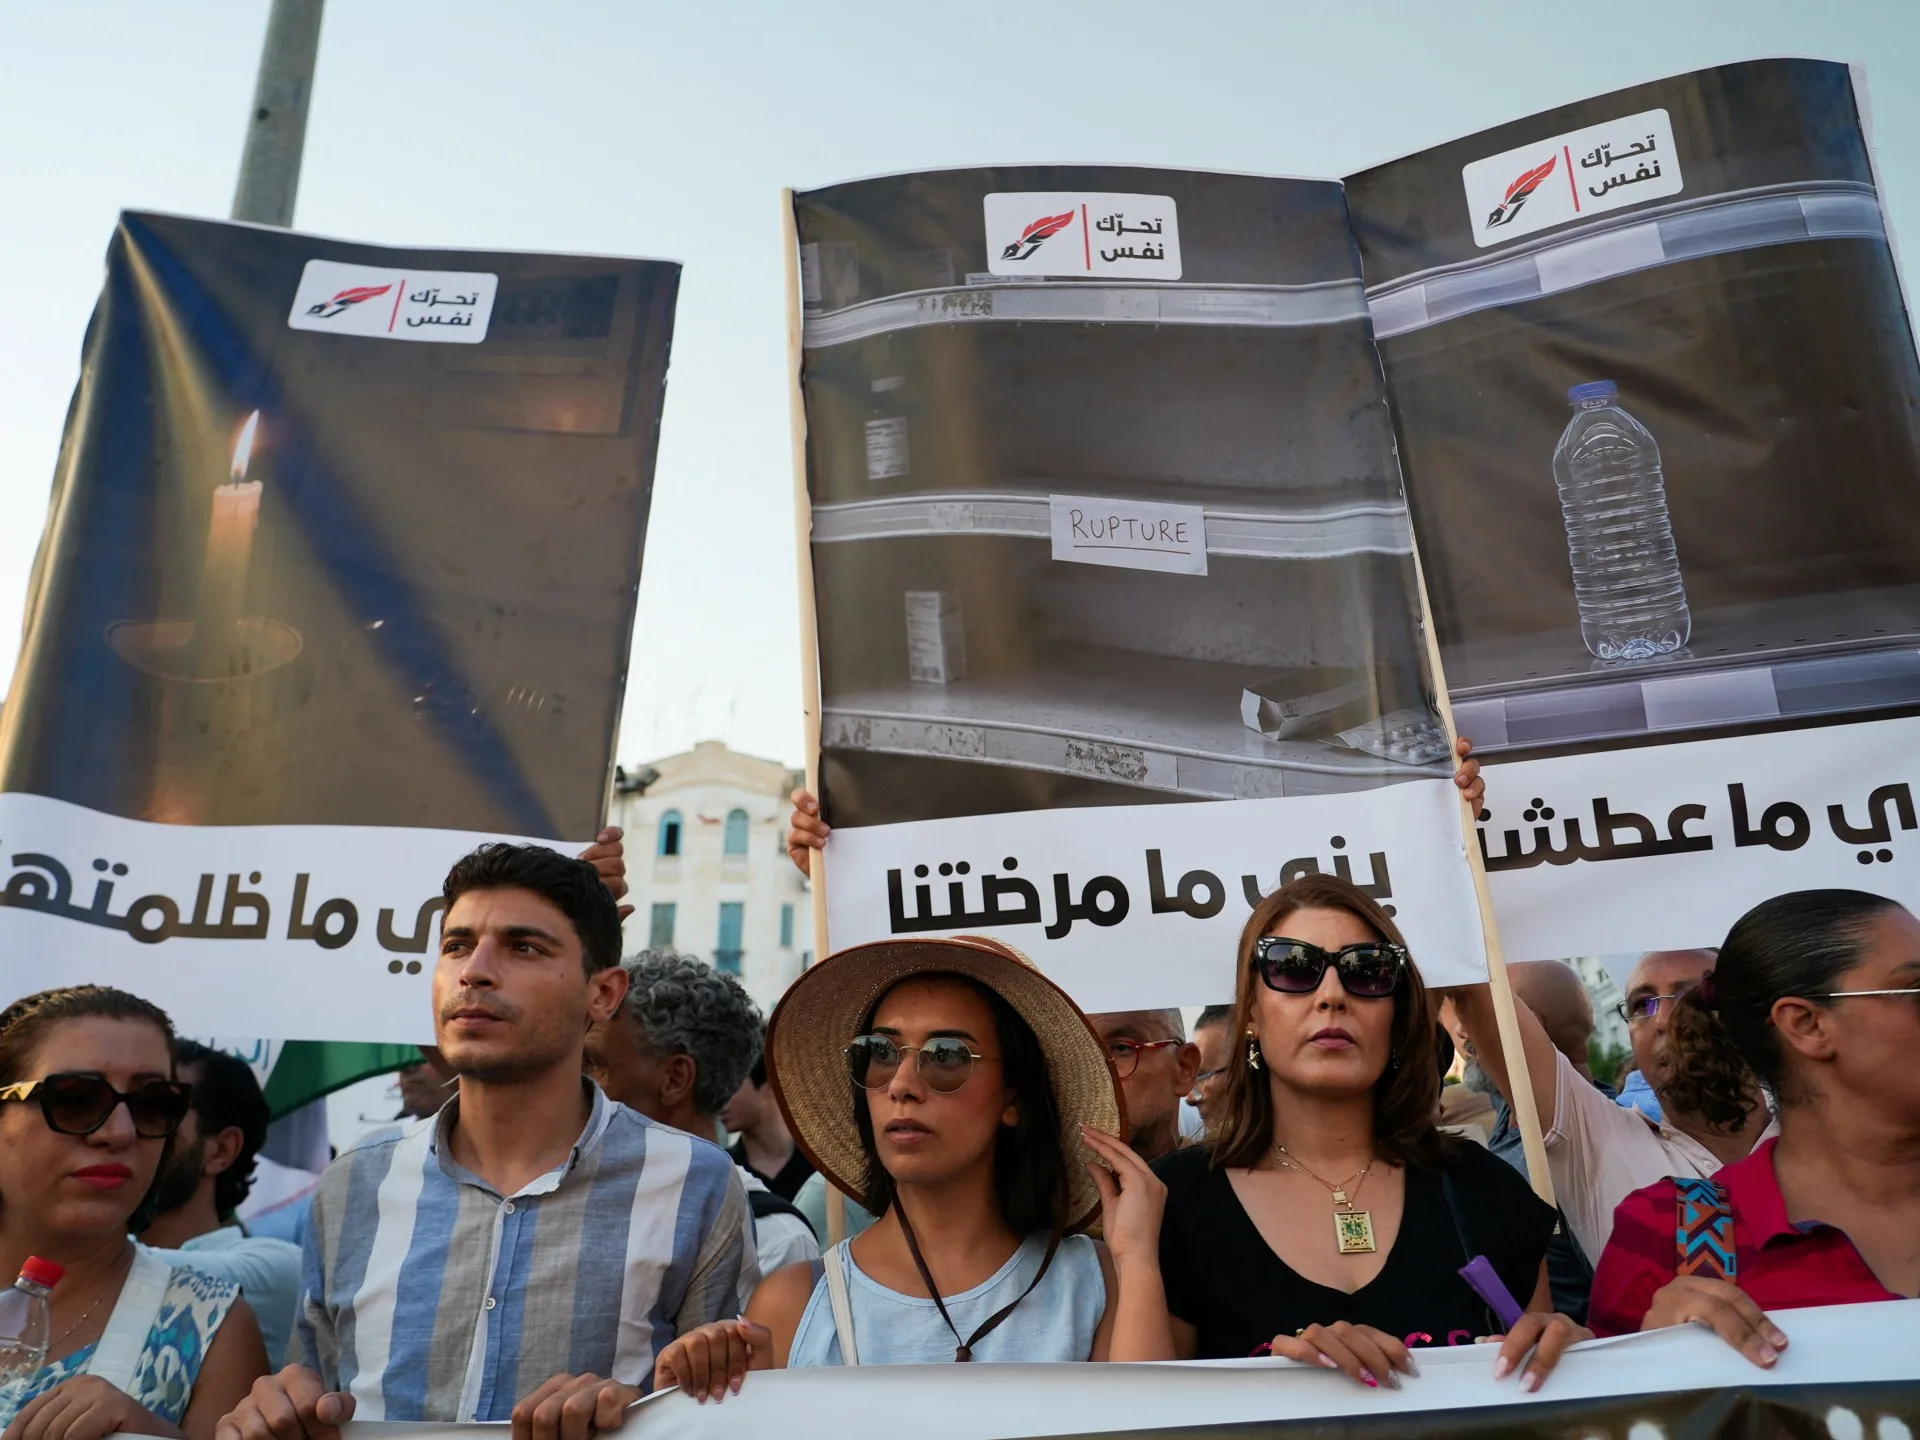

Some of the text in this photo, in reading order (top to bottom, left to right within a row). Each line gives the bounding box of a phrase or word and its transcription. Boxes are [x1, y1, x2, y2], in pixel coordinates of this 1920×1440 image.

[1588, 159, 1661, 197] نفس
[1100, 242, 1164, 262] نفس
[406, 312, 473, 327] نفس
[1069, 509, 1189, 543] RUPTURE
[1727, 782, 1811, 852] ما
[0, 840, 271, 945] ظلمته
[286, 873, 359, 950] ما
[887, 856, 1130, 940] مرضتنا
[1145, 848, 1226, 919] ما
